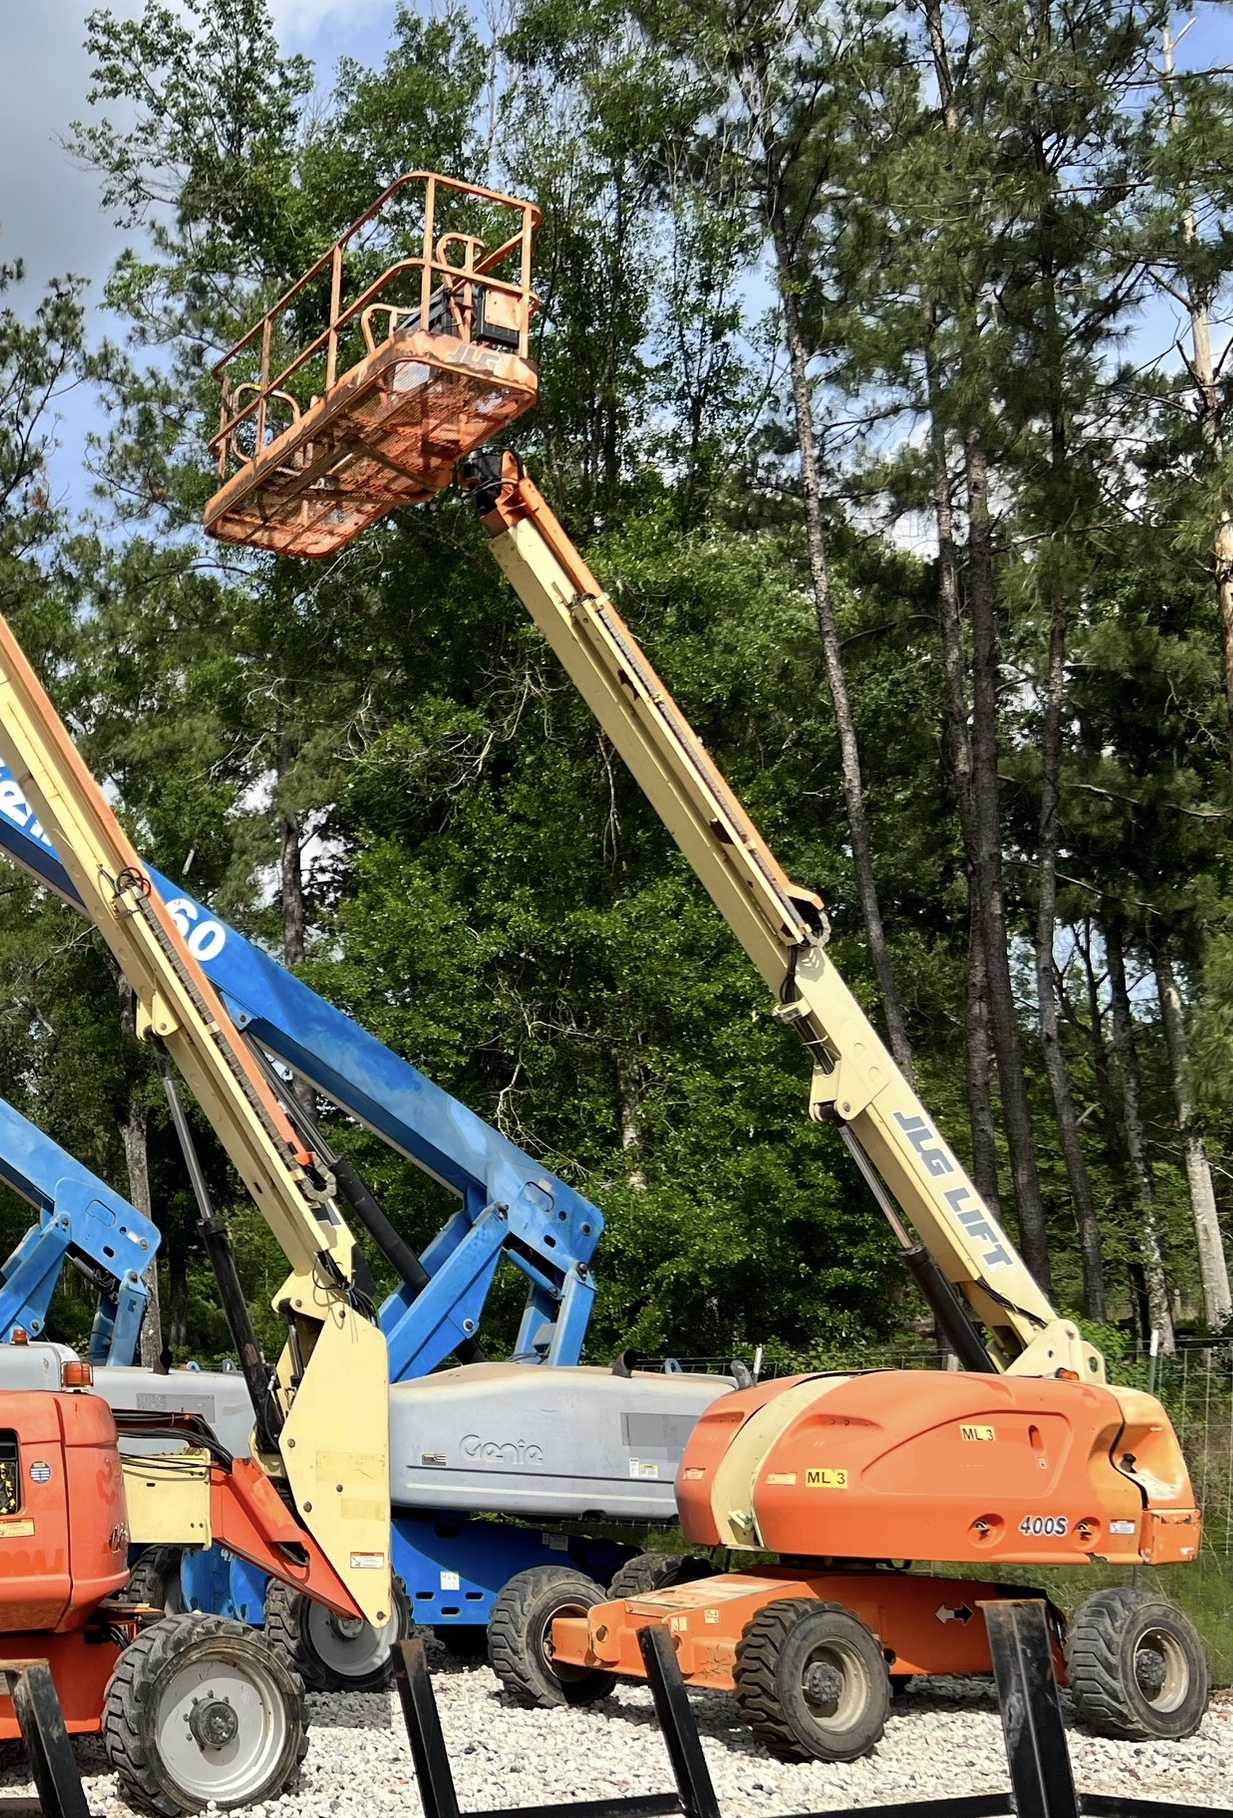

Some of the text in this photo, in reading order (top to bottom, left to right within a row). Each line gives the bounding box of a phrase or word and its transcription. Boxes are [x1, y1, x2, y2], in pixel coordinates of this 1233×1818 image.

[892, 1111, 1014, 1268] JLG LIFT
[962, 1428, 994, 1441] ML 3
[459, 1434, 543, 1466] Genie
[807, 1471, 831, 1484] ML
[837, 1472, 846, 1485] 3
[1019, 1515, 1068, 1537] 400S
